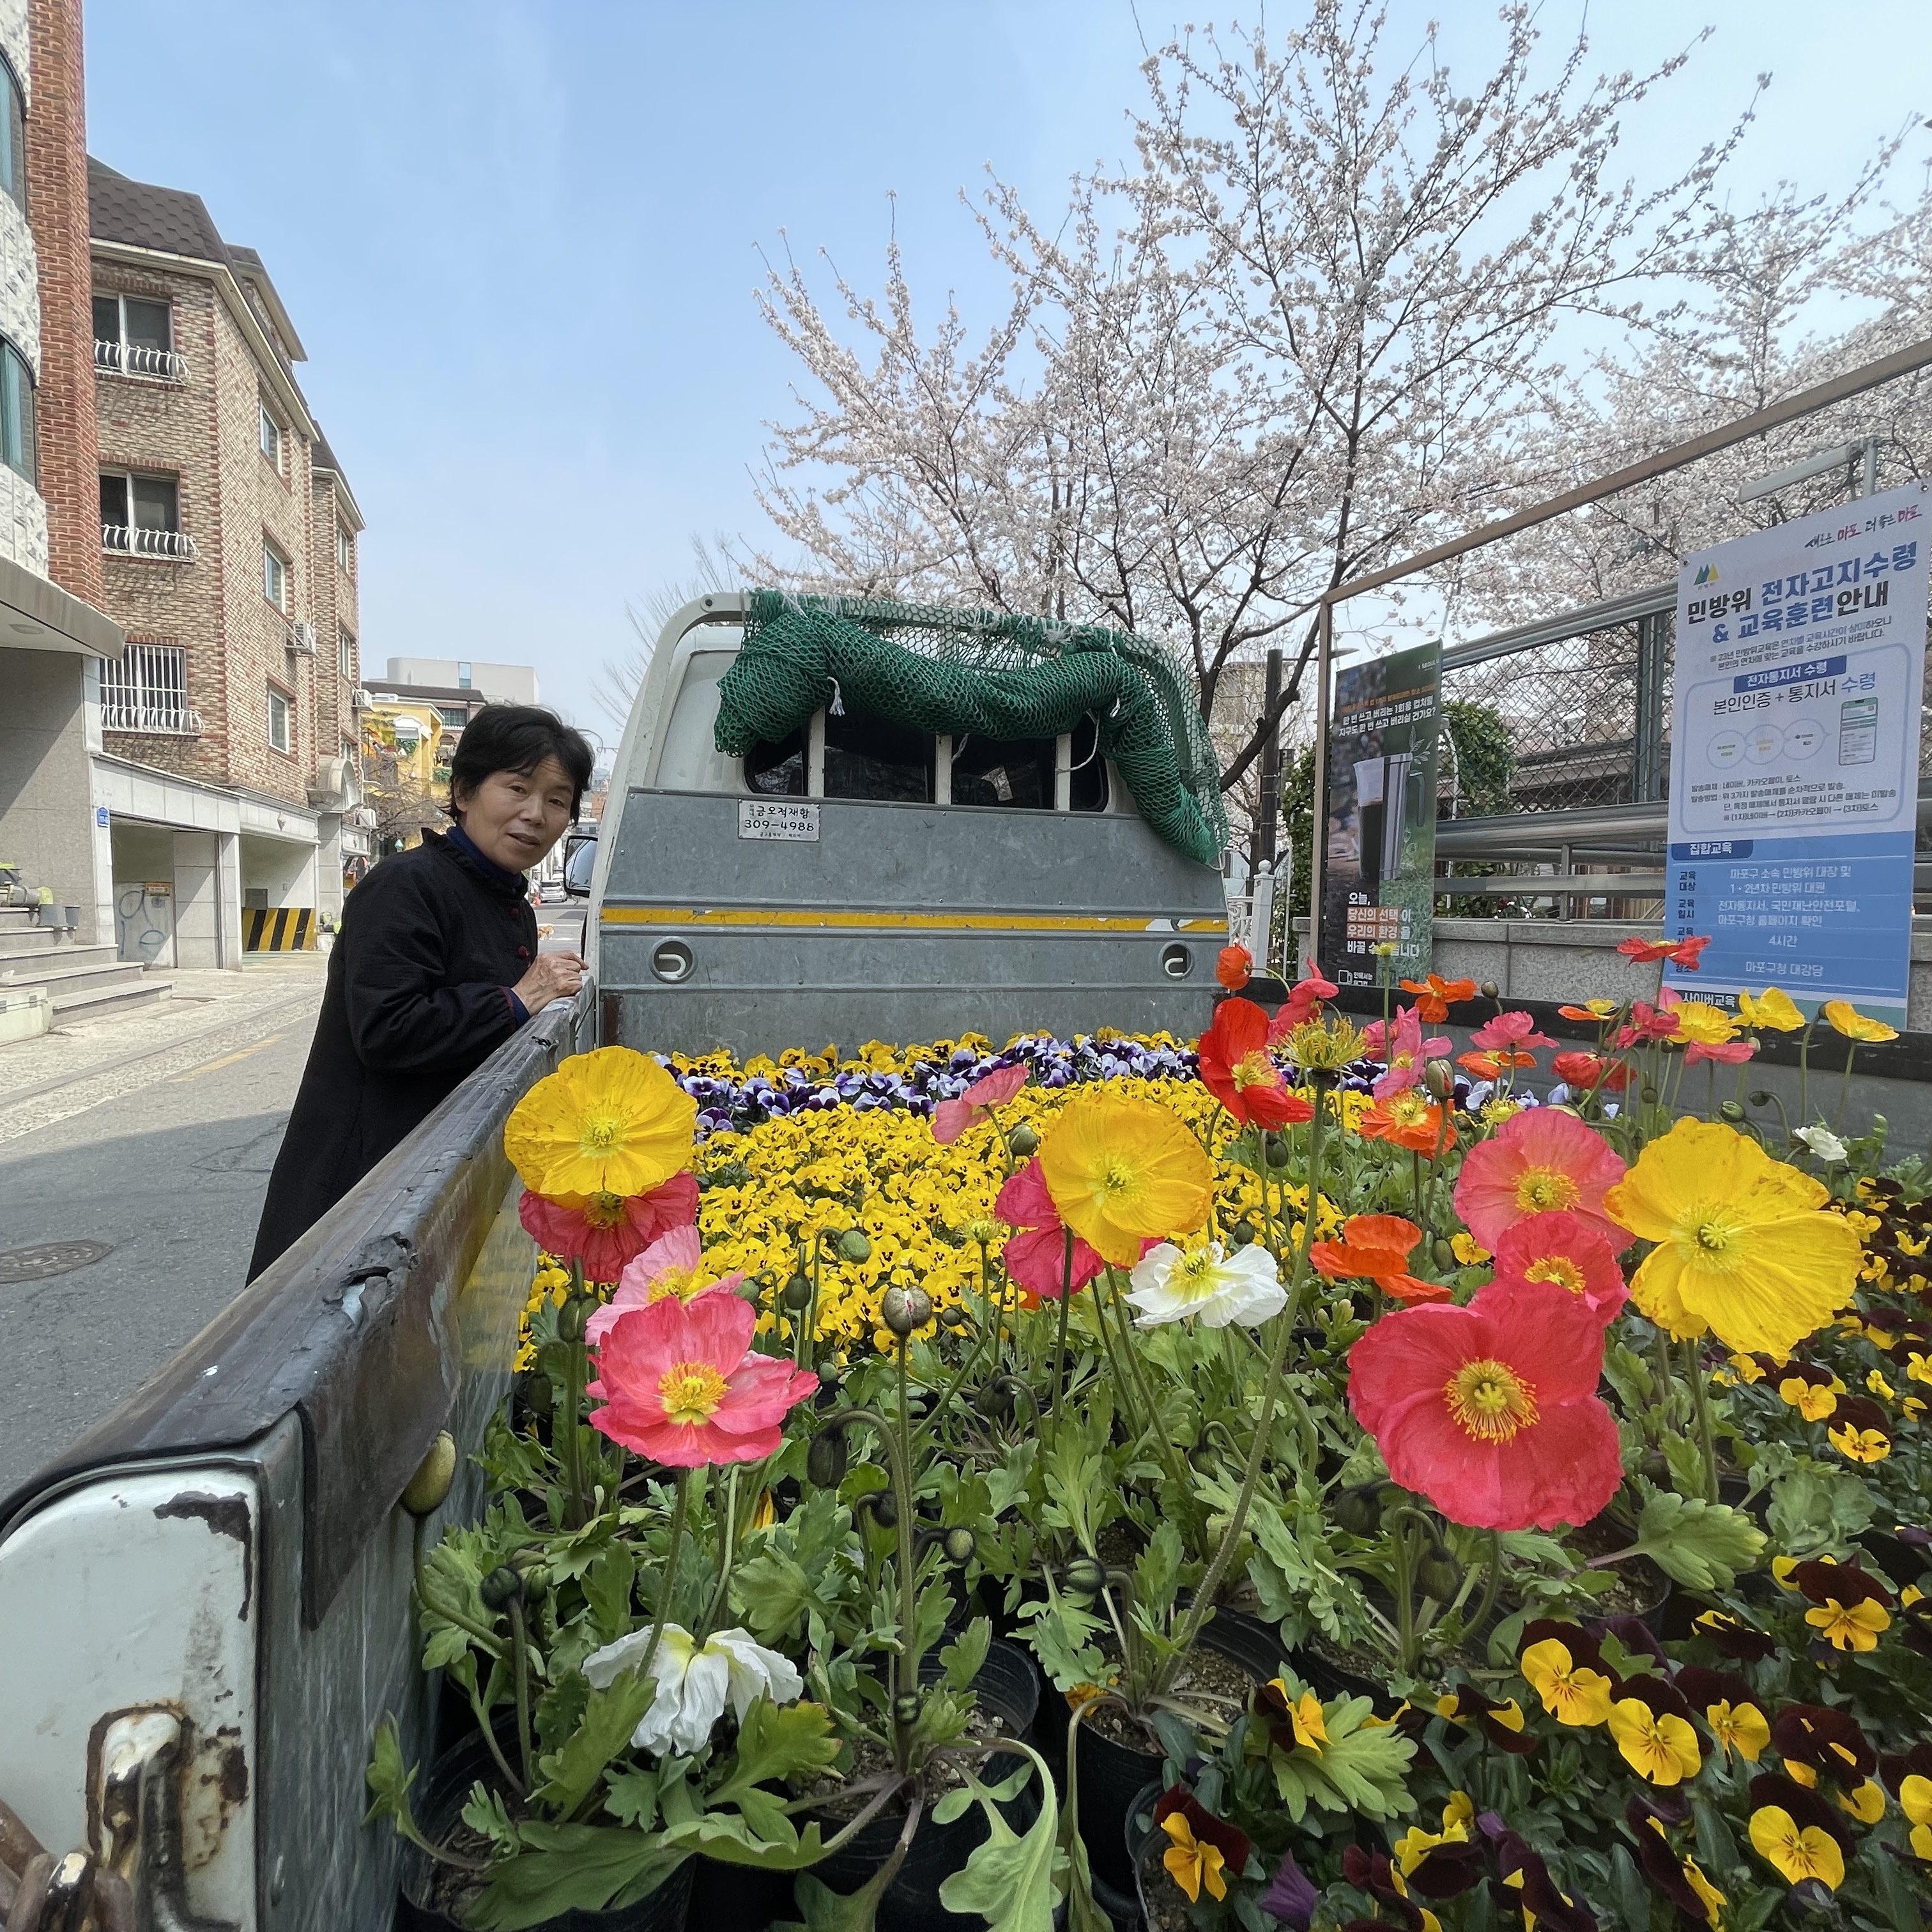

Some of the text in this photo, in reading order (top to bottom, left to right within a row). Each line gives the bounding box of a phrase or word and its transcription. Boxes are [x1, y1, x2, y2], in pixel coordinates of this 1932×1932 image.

[1837, 523, 1862, 541] 마포
[1865, 517, 1876, 532] 더
[1879, 514, 1896, 529] 좋은
[1898, 504, 1922, 523] 마포
[1687, 541, 1917, 625] 민방위 전자고지수령
[1712, 580, 1889, 643] & 교육훈련안내
[1718, 659, 1739, 671] 본인의
[1805, 636, 1847, 652] 수강하시기
[1718, 650, 1735, 661] 23년
[1747, 661, 1827, 687] 전자통지서 수령
[1713, 671, 1876, 716] 본인인증 + 통지서 수령
[1351, 714, 1357, 723] 번
[1359, 710, 1372, 721] 쓰고
[1374, 707, 1393, 718] 버리는
[1395, 701, 1412, 714] 1회용
[1339, 706, 1436, 737] 지구도 한 번 쓰고 버리실 건가요?
[1786, 774, 1801, 783] 토스
[1731, 790, 1749, 799] 3가지
[1690, 842, 1733, 855] 집합교육
[1680, 871, 1696, 880] 교육
[1730, 865, 1851, 879] 마포구 소속 민방위 대장 및
[1679, 882, 1696, 891] 대상
[1772, 882, 1802, 894] 민방위
[1804, 882, 1825, 893] 대원
[1348, 892, 1370, 905] 오늘,
[1678, 899, 1694, 908] 교육
[1348, 908, 1411, 923] 당신의 선택 이
[1678, 910, 1694, 919] 일시
[1718, 914, 1822, 926] 마포구청 홈페이지 확인
[1348, 924, 1411, 939] 우리의 환경 을
[1677, 927, 1693, 936] 교육
[1347, 940, 1366, 954] 바꿀
[1768, 935, 1798, 947] 4시간
[1745, 961, 1823, 977] 마포구청 대강당
[1683, 992, 1736, 1008] 사이버교육
